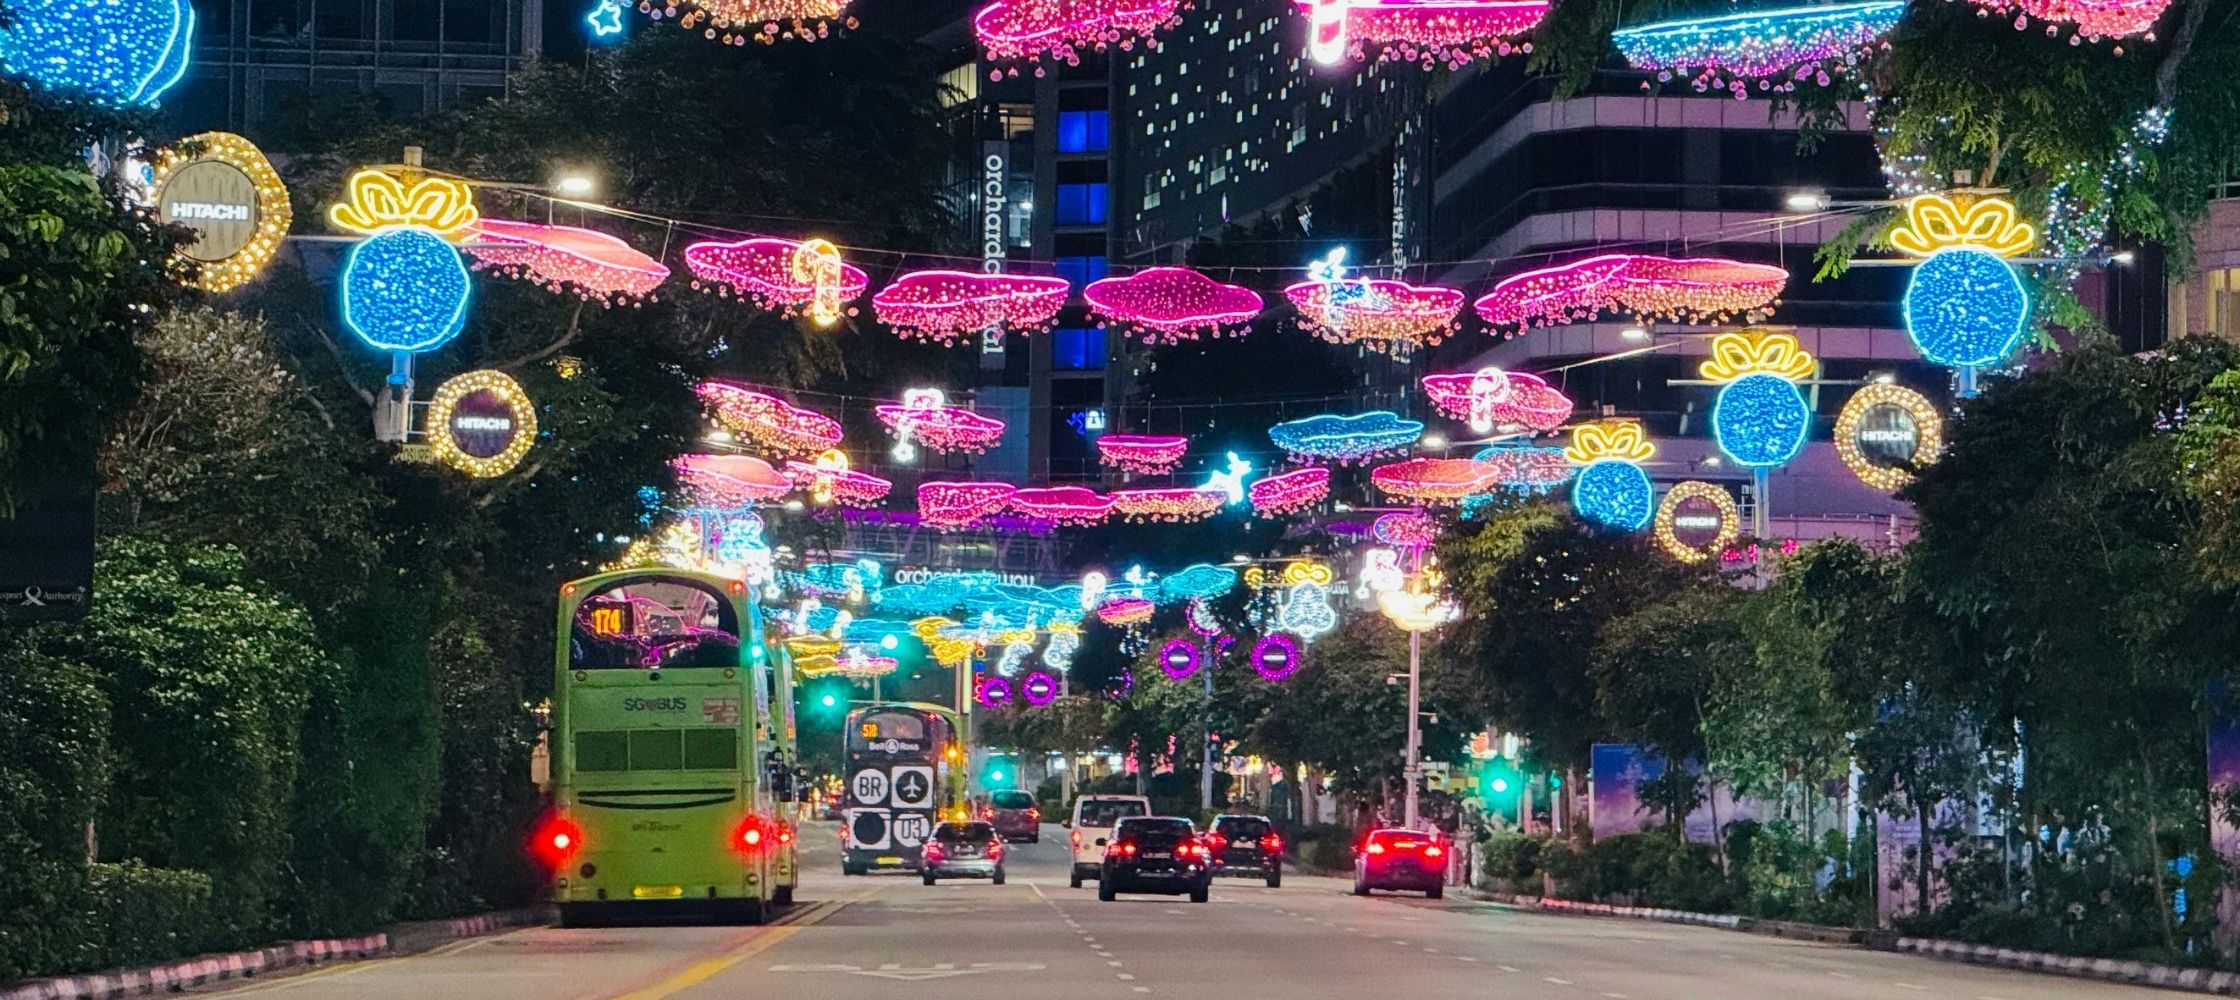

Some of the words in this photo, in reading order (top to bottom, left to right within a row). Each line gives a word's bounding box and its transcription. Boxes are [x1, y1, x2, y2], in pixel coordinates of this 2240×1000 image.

[172, 202, 249, 220] HITACHI
[983, 154, 1006, 354] orchardcal
[457, 417, 511, 430] HITACHI
[1861, 430, 1912, 442] HITACHI
[593, 608, 622, 634] 174
[859, 776, 882, 797] BR
